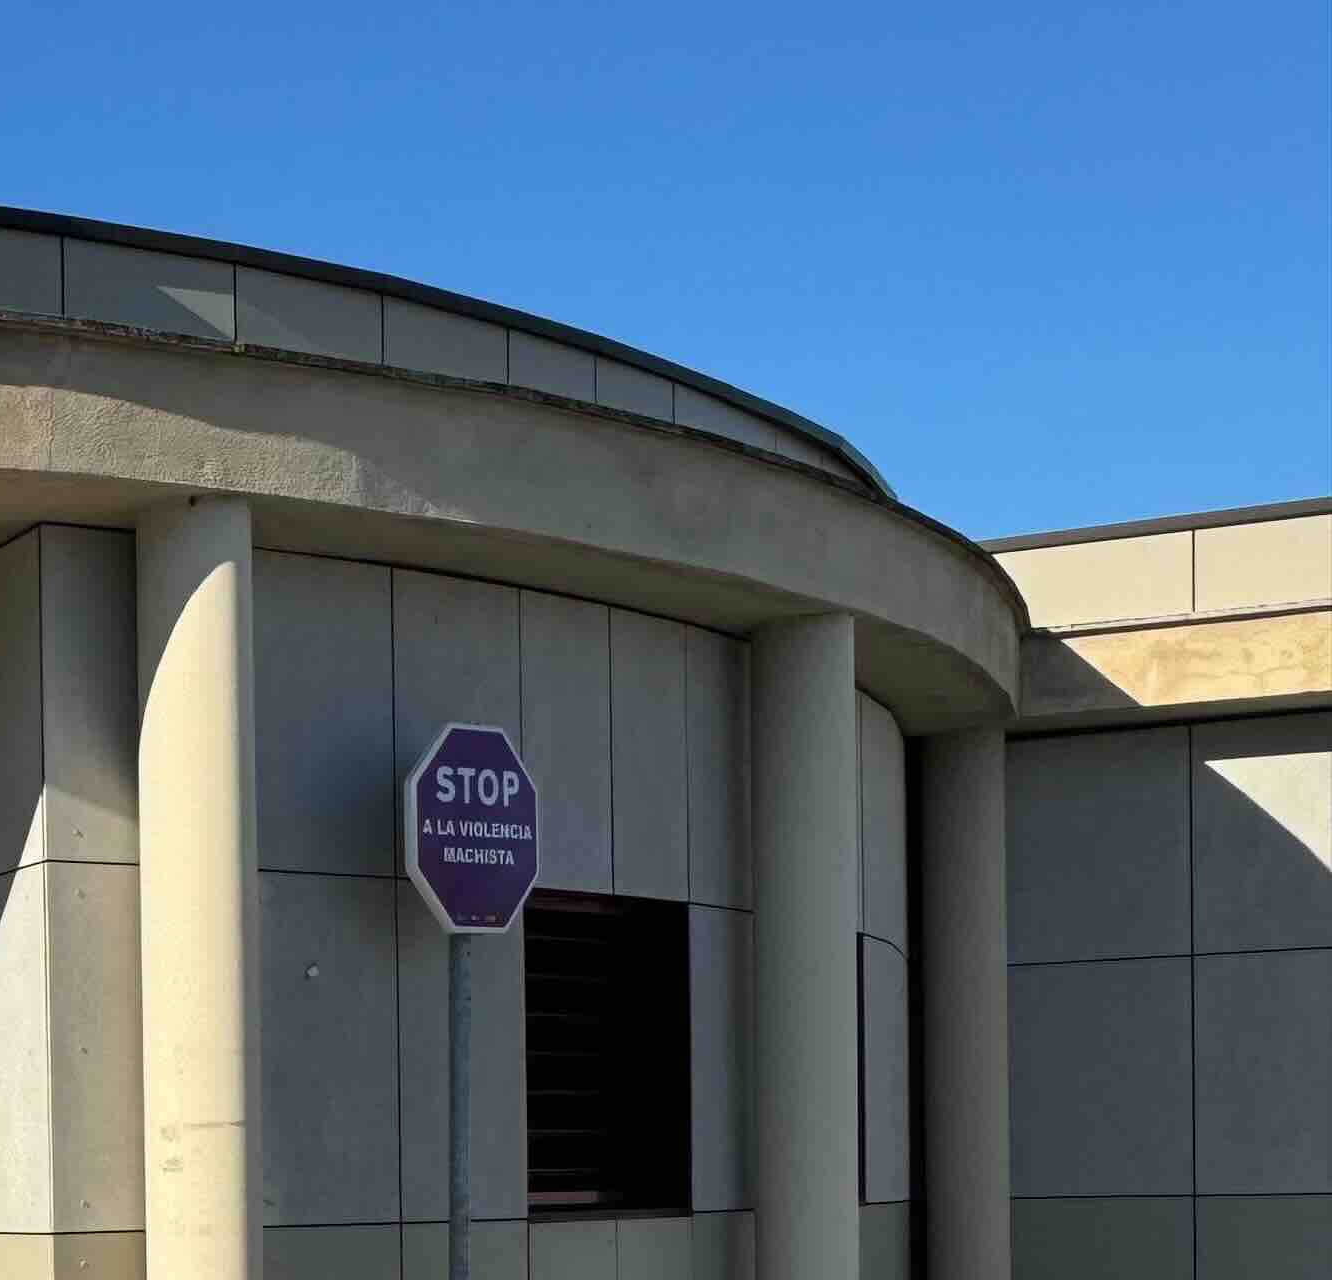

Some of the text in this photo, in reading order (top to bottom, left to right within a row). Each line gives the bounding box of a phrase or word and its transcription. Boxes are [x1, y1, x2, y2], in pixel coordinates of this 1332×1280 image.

[435, 764, 521, 808] STOP
[422, 818, 534, 841] A LA VIOLENCIA
[443, 846, 516, 866] MACHISTA
